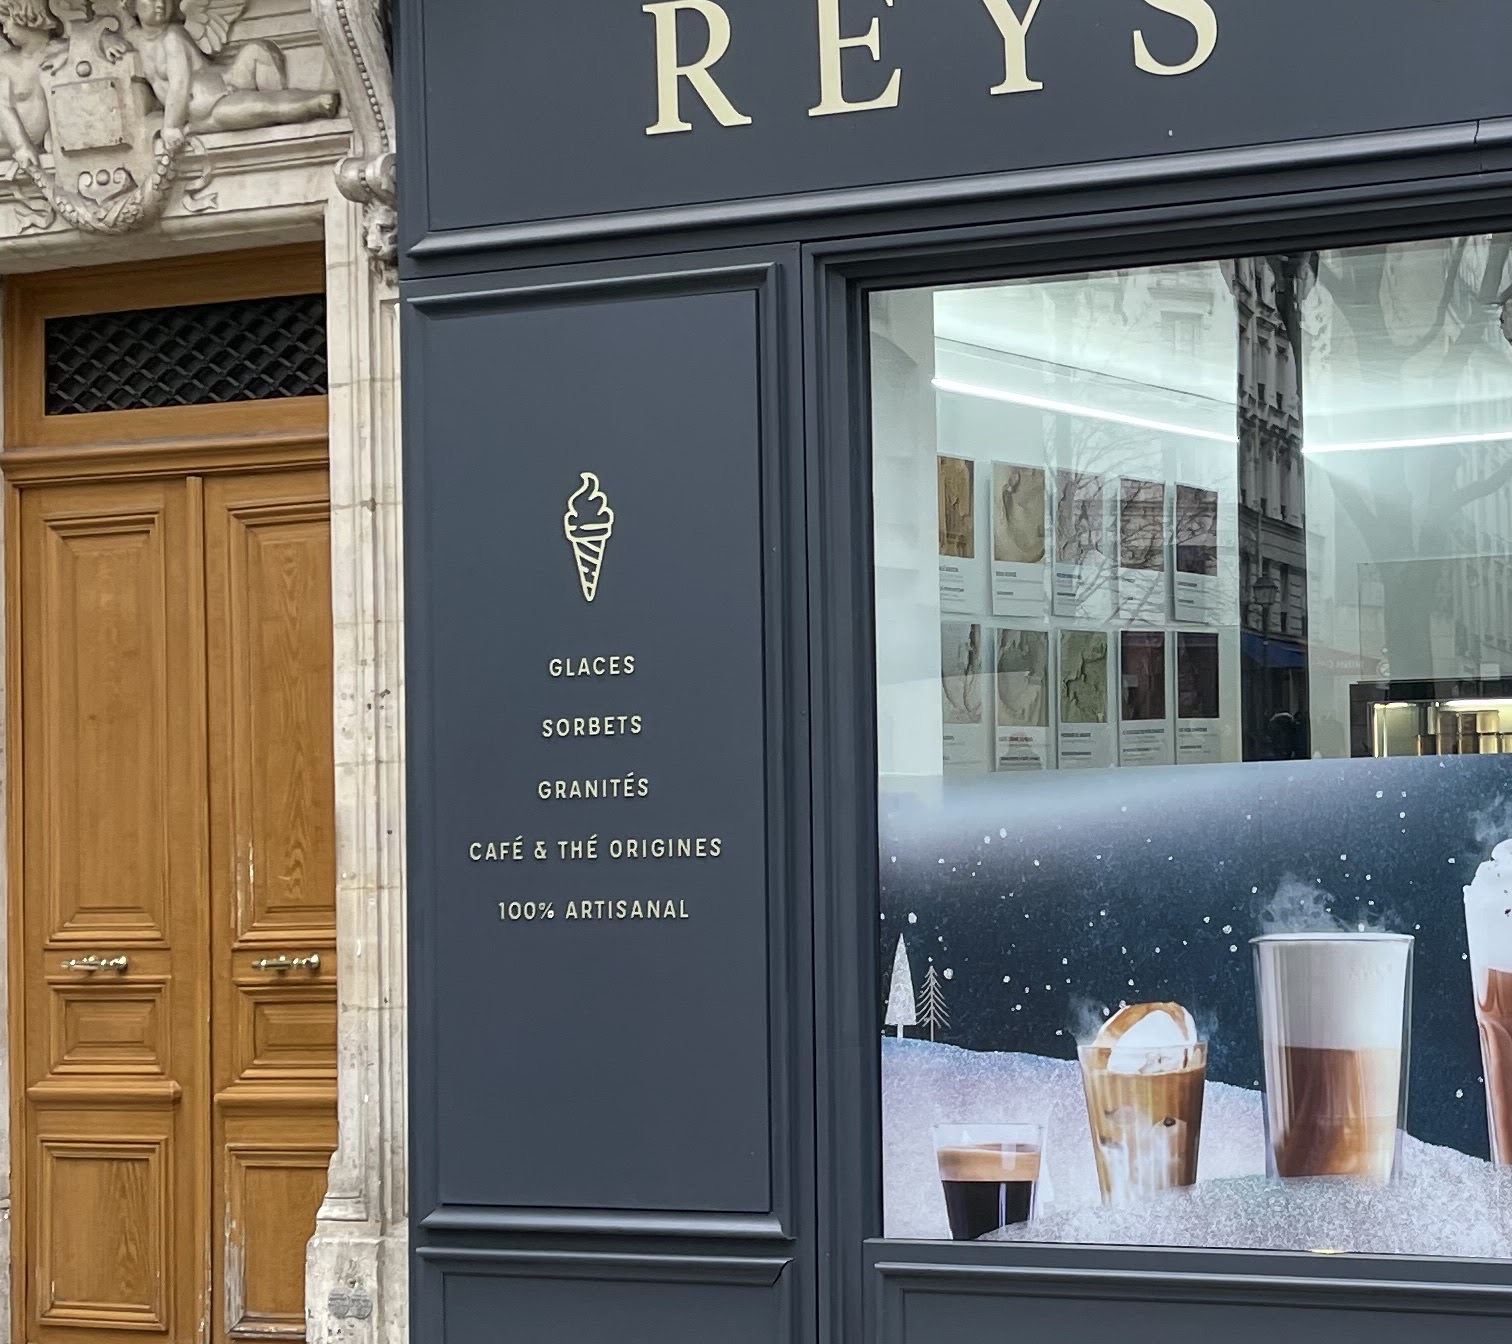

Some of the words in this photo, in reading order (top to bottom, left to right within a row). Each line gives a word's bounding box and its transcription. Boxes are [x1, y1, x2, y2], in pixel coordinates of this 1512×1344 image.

[549, 655, 635, 677] GLACES
[542, 715, 642, 738] SORBETS
[538, 771, 649, 799] GRANITÉS
[469, 835, 524, 861] CAFÉ
[534, 841, 547, 859] &
[557, 833, 598, 860] THÉ
[609, 837, 722, 858] ORIGINES
[498, 901, 555, 920] 100%
[565, 899, 689, 919] ARTISANAL
